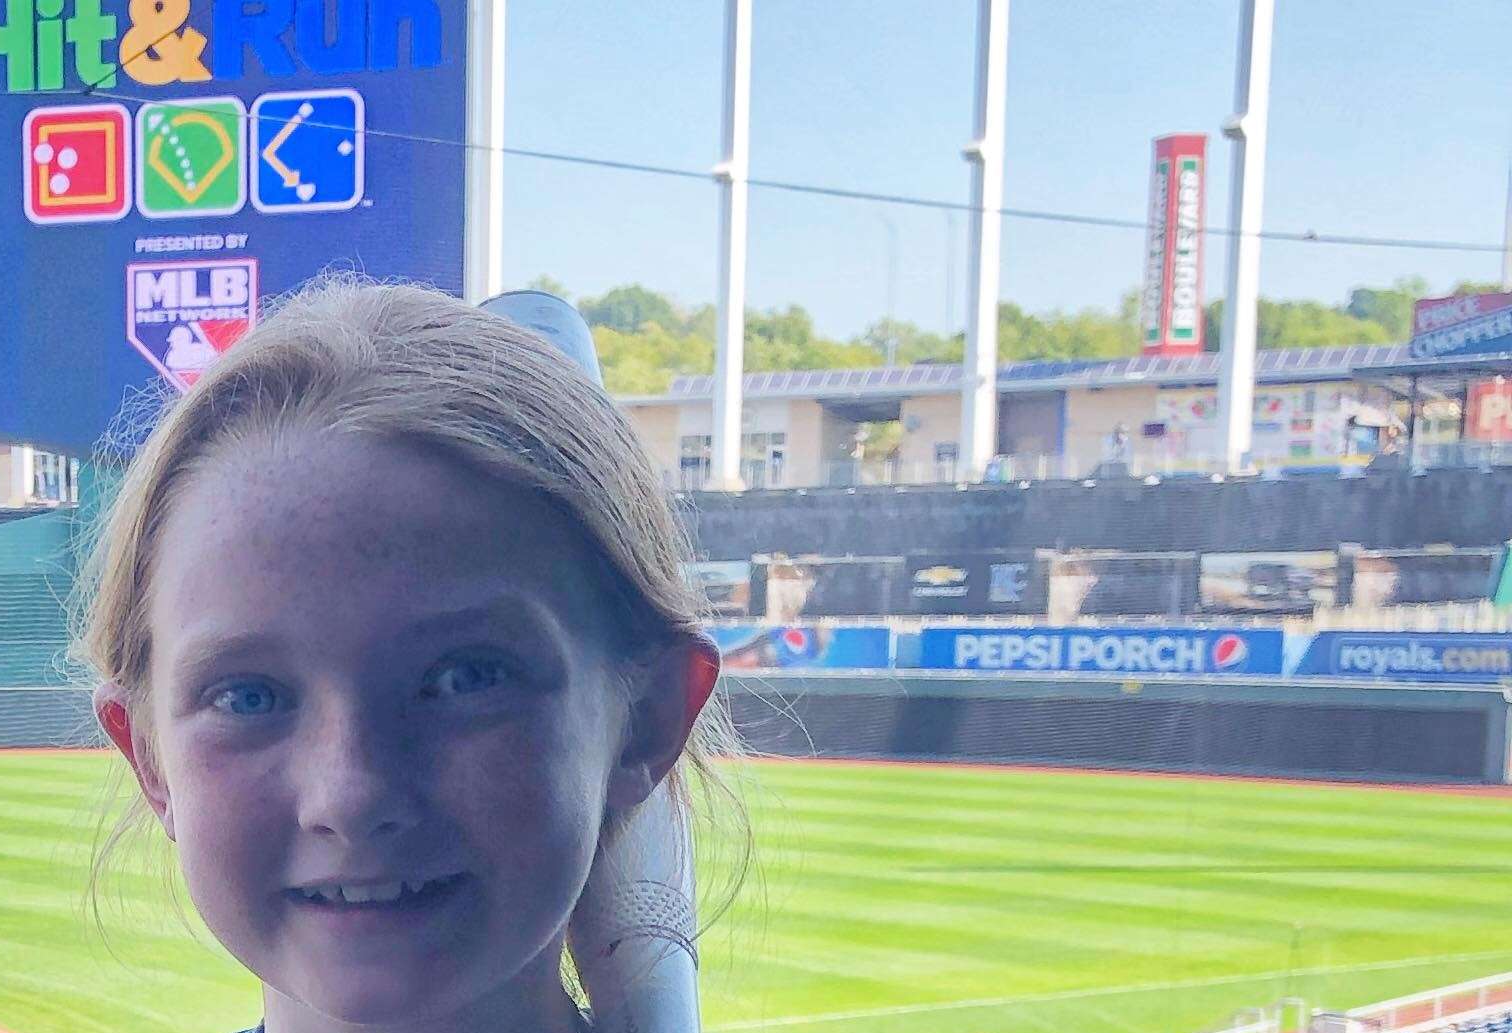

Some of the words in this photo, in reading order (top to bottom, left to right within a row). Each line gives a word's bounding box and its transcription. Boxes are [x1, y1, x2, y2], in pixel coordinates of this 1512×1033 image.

[135, 235, 224, 253] PRESENTED
[225, 233, 249, 249] BY
[135, 268, 248, 309] MLB
[135, 307, 249, 323] NETWORK
[955, 634, 1061, 669] PEPSI
[1070, 635, 1204, 672] PORCH
[1338, 639, 1511, 674] royals.com
